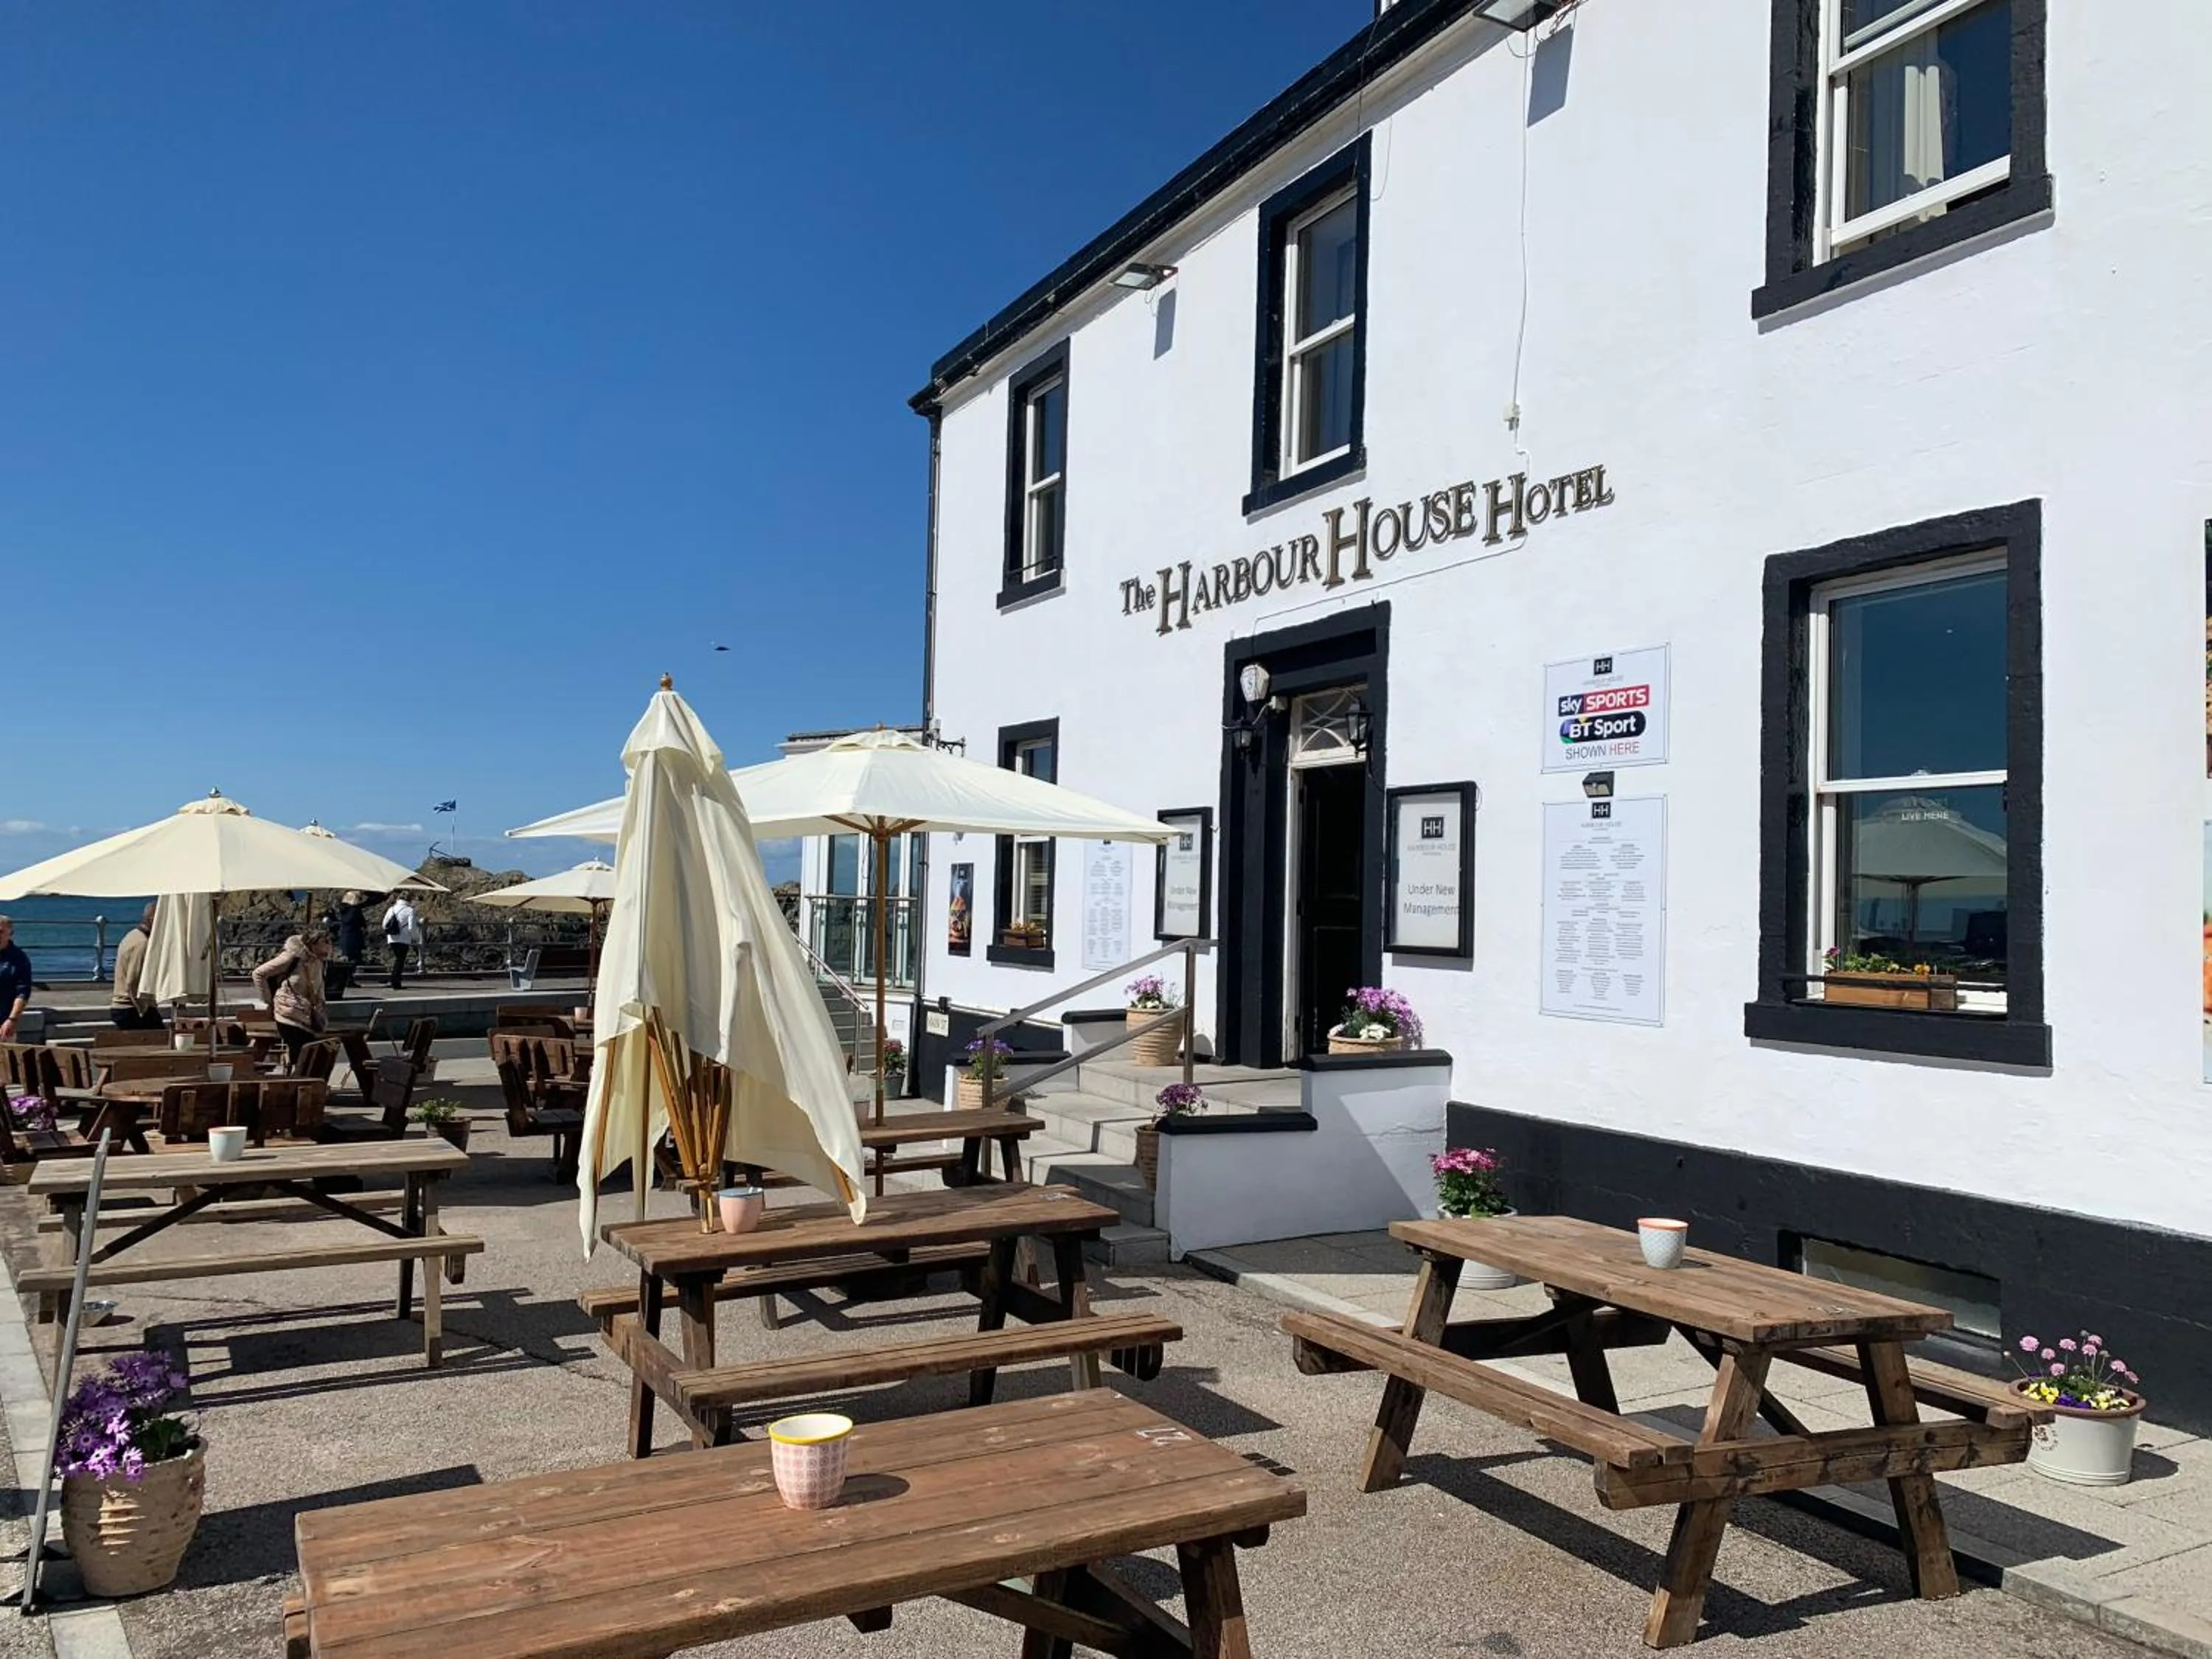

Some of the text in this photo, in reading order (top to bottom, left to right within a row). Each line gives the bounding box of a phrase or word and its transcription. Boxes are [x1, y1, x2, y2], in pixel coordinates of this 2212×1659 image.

[1119, 464, 1615, 636] The HARBOUR HOUSE HOTEL
[1560, 687, 1646, 714] sky SPORTS
[1569, 714, 1636, 738] BT Sport
[1565, 741, 1640, 760] SHOWN HERE
[1423, 819, 1442, 836] HH
[1408, 884, 1455, 896] Under New
